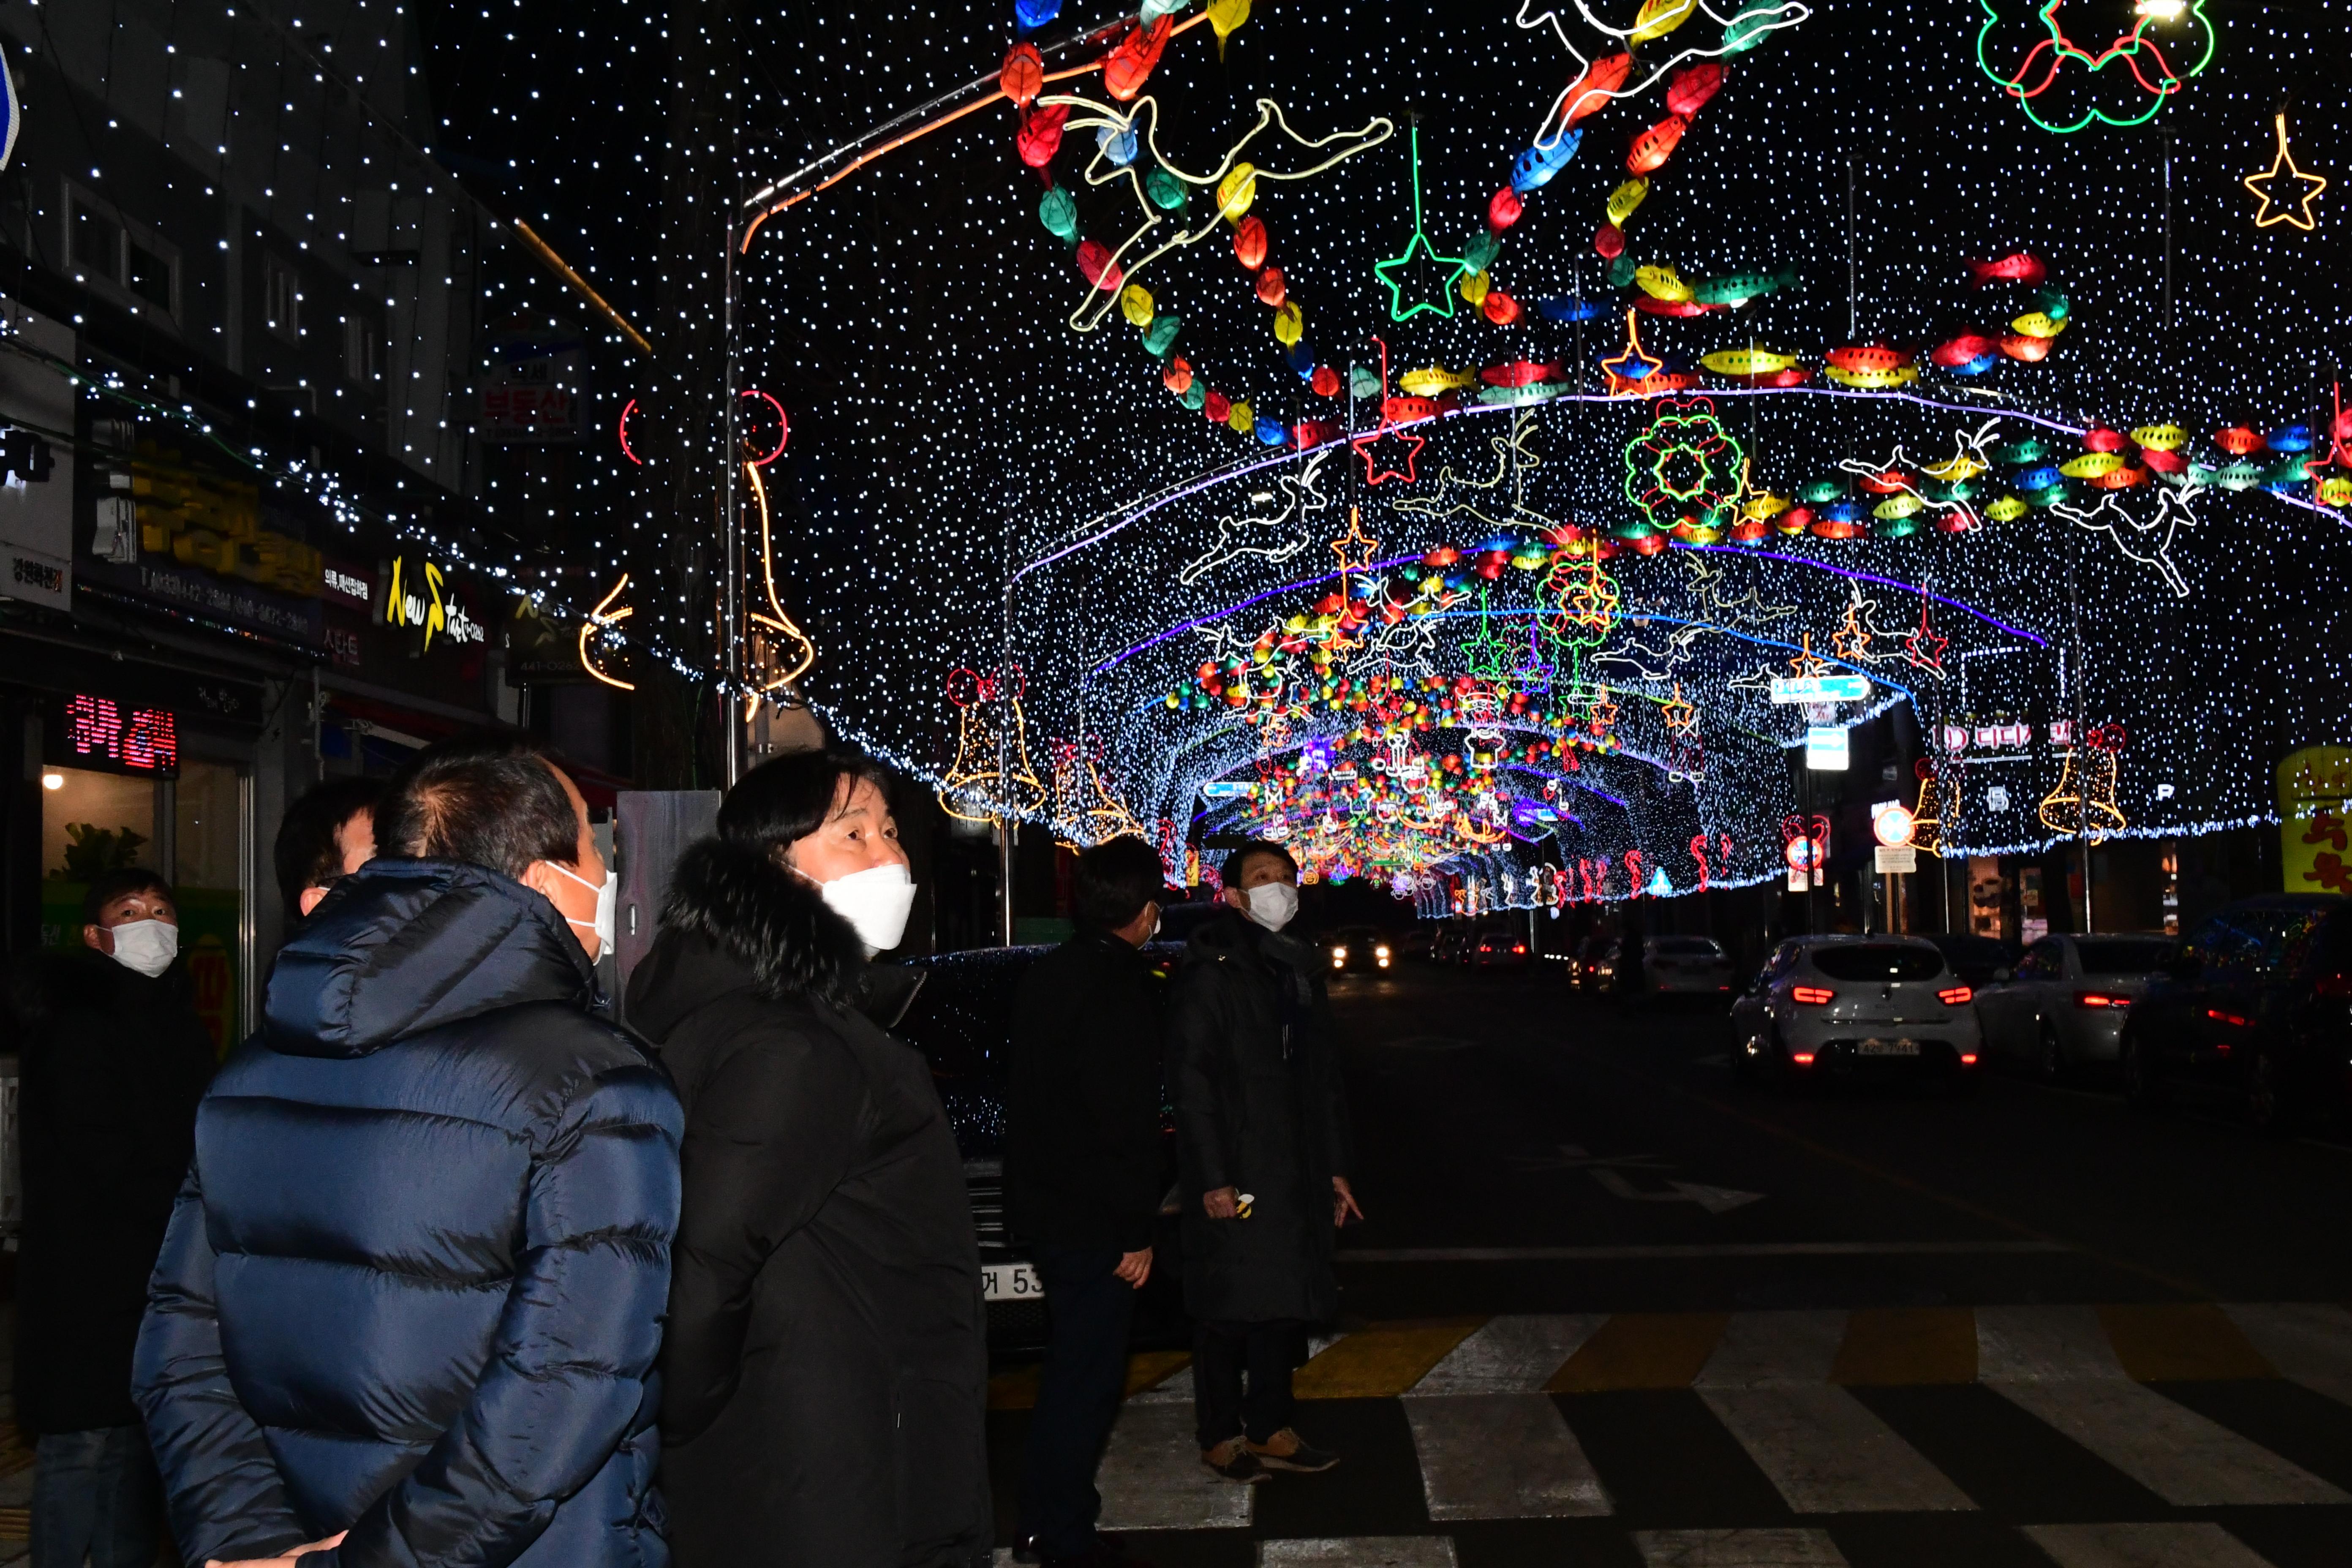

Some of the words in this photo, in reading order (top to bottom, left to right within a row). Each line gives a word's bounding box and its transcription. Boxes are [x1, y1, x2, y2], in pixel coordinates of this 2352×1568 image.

[483, 389, 568, 425] 부동산
[324, 568, 368, 601] 의류,패션잡화점
[387, 555, 425, 627] New
